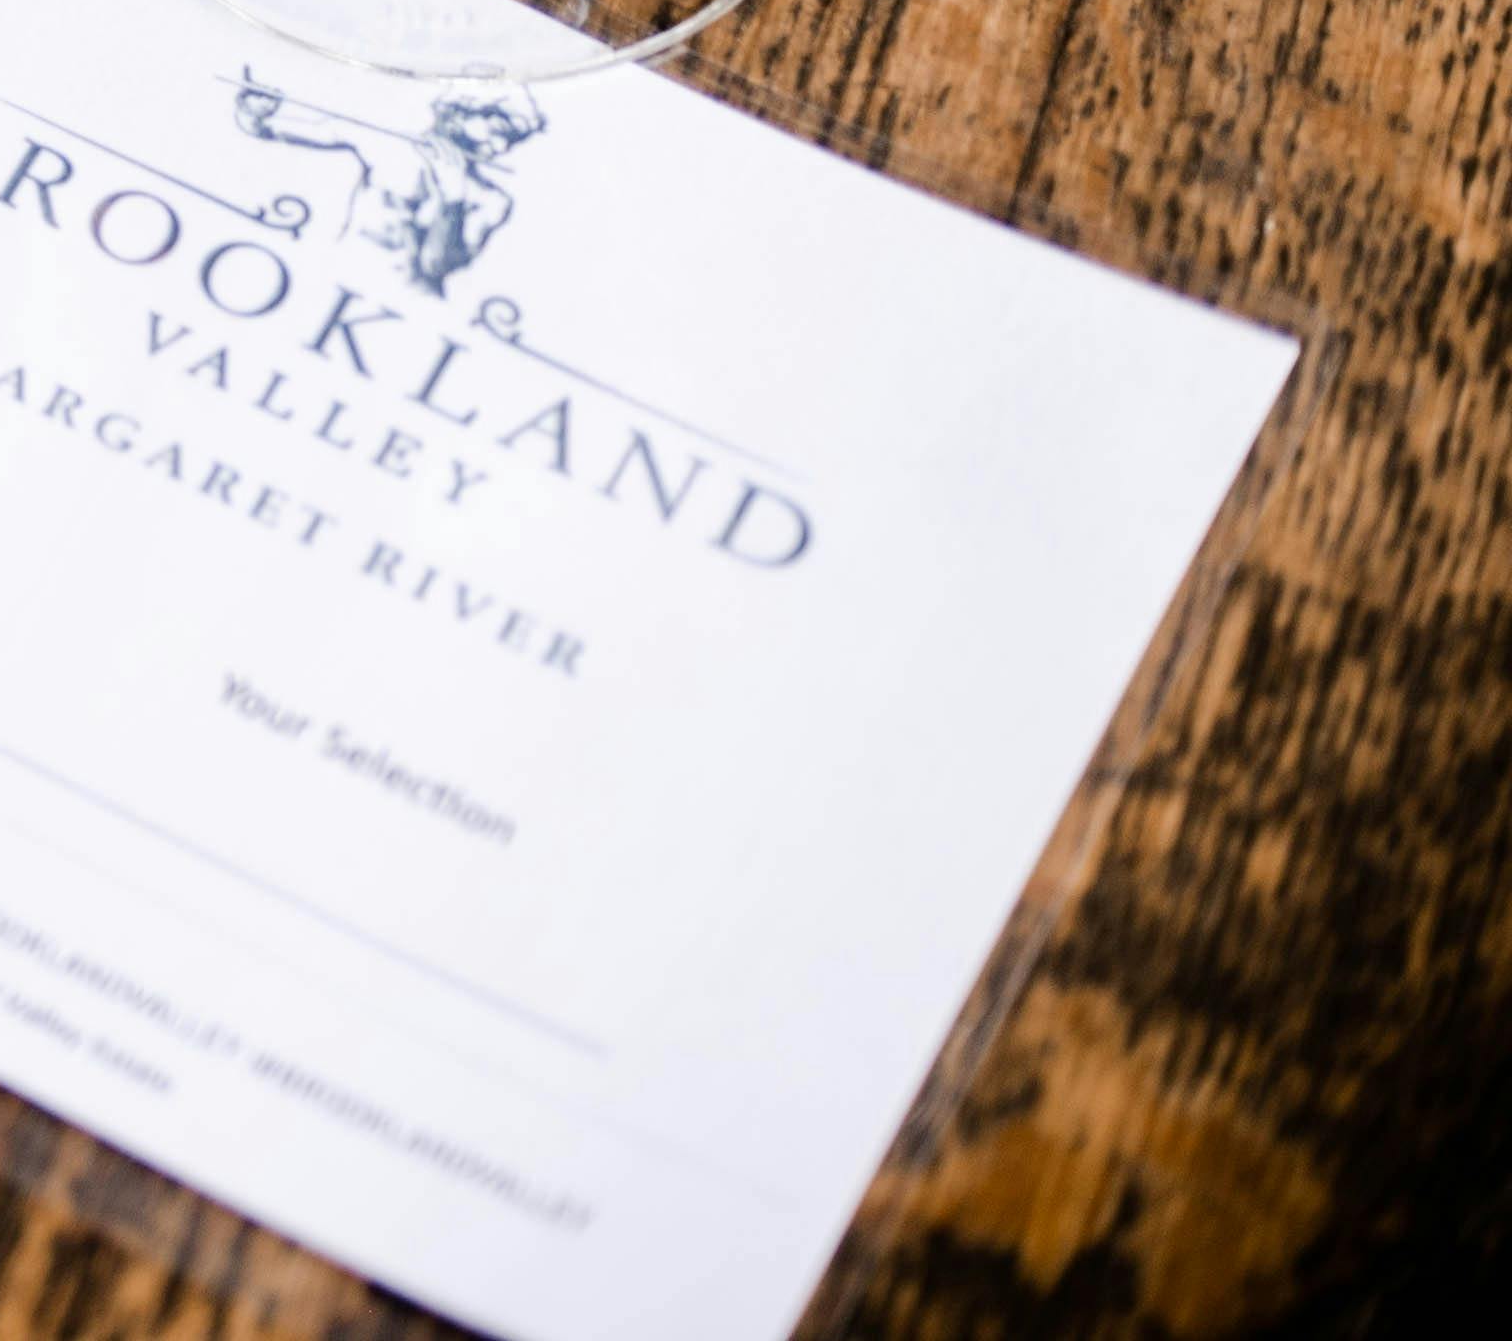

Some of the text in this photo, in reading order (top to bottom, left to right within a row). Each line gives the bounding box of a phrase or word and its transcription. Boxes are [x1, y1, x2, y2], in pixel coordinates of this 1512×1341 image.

[148, 310, 489, 506] VALLEY
[359, 539, 586, 678] RIVER
[219, 672, 517, 846] Your Selection
